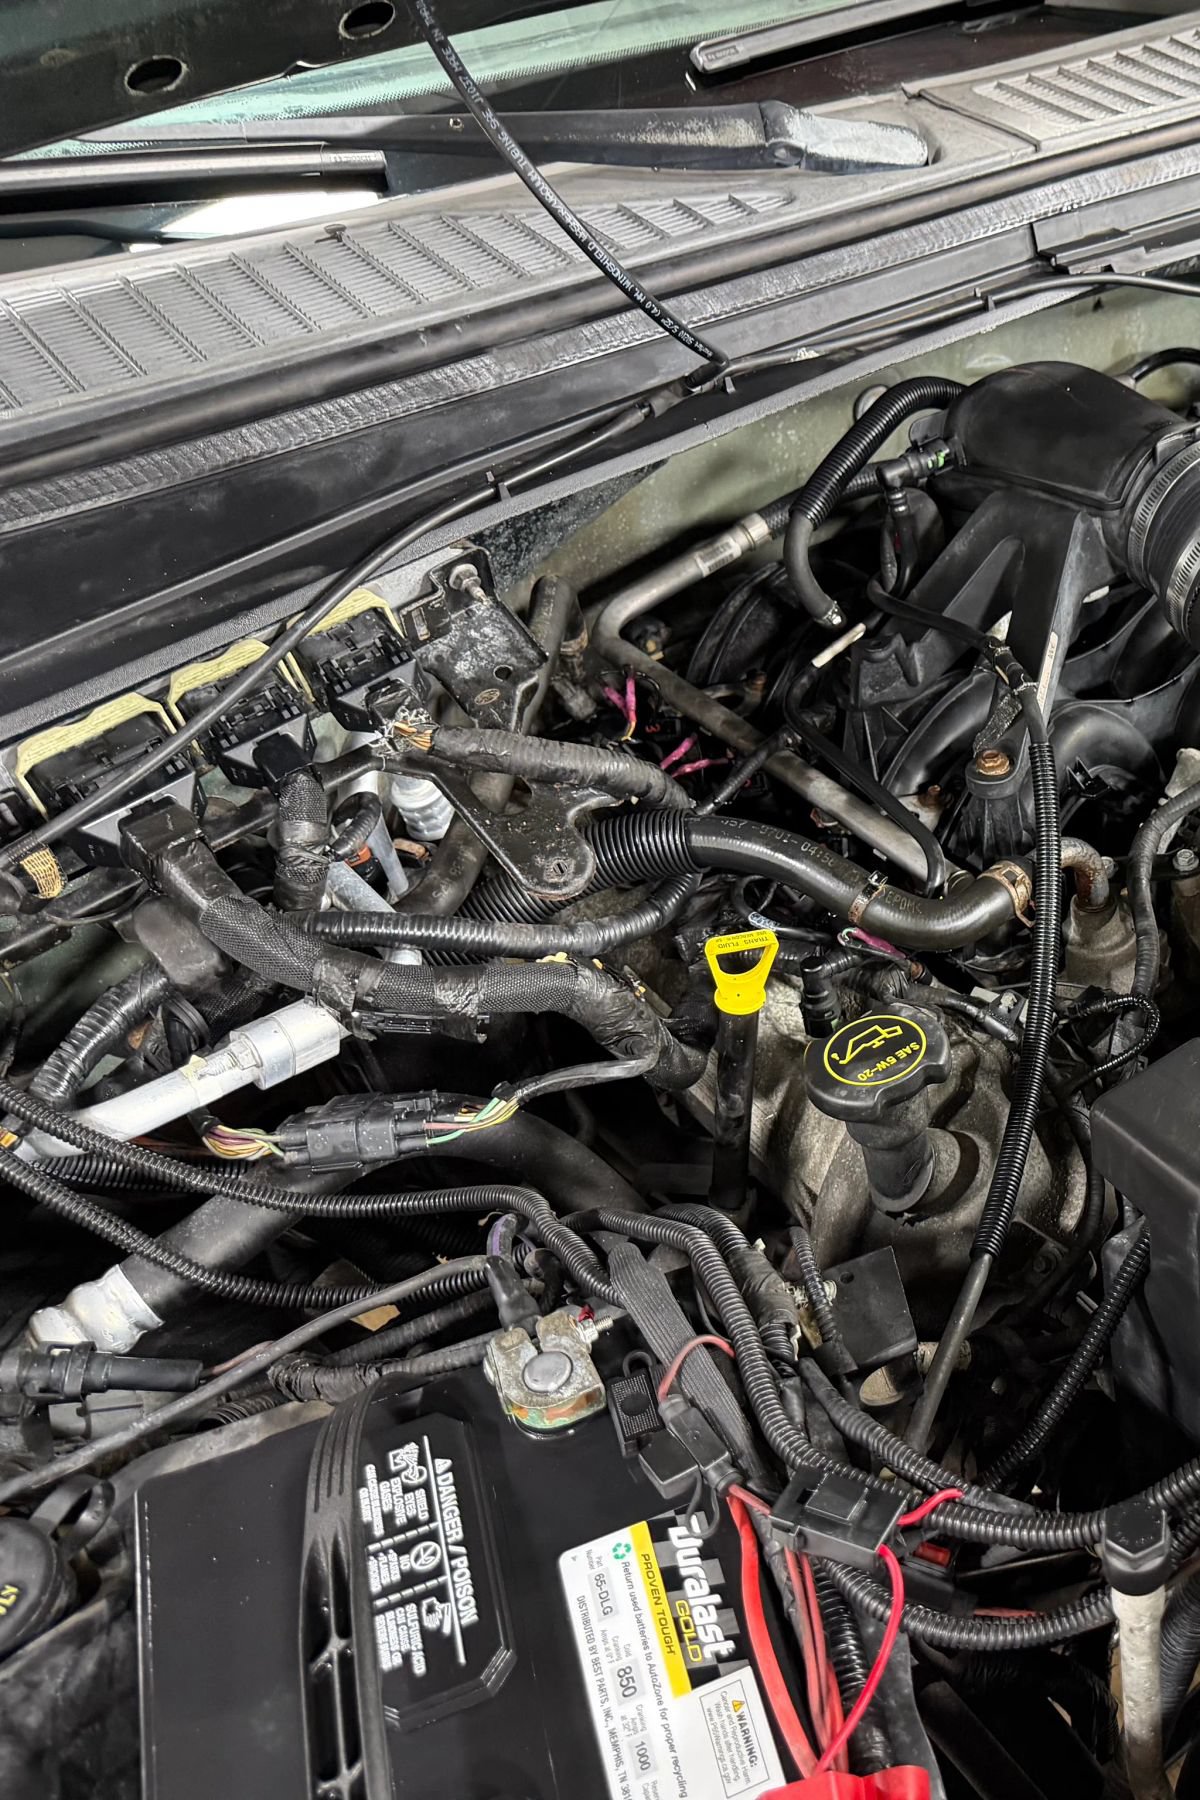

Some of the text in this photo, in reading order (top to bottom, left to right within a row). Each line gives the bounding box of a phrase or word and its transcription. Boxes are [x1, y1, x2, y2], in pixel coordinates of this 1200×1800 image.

[430, 27, 444, 42] IN
[441, 45, 463, 72] MADE
[458, 73, 484, 105] J1037
[481, 107, 500, 129] SAE
[497, 130, 528, 168] TUBING
[717, 935, 768, 948] TRANS FLUID
[857, 1041, 919, 1080] SAE 5W-20
[379, 1480, 392, 1513] GASES
[389, 1476, 407, 1527] EXPLOSIVE
[404, 1491, 416, 1518] EYES
[414, 1487, 429, 1521] SHIELD
[435, 1471, 464, 1543] DANGER
[399, 1554, 410, 1571] NO
[585, 1549, 595, 1570] Number
[449, 1555, 478, 1628] POISON
[593, 1572, 613, 1616] 65-DLG
[641, 1552, 662, 1605] PROVEN
[667, 1514, 734, 1659] Duralast
[395, 1606, 405, 1624] CAN
[576, 1595, 594, 1644] DISTRIBUTED
[674, 1599, 703, 1663] GOLD
[404, 1602, 426, 1676] SULFURIC ACID
[588, 1644, 597, 1656] BY
[590, 1656, 602, 1676] BEST
[616, 1665, 638, 1698] 850
[621, 1560, 689, 1798] Return used batteries to AutoZone for proper recycling
[595, 1677, 609, 1707] PARTS,
[720, 1690, 731, 1713] Cancer
[714, 1702, 723, 1719] Wash
[726, 1713, 735, 1725] and
[718, 1719, 729, 1738] hands
[735, 1711, 758, 1767] WARNING:
[607, 1727, 624, 1770] MEMPHIS,
[634, 1740, 651, 1771] 1000
[724, 1739, 733, 1753] after
[729, 1725, 746, 1766] Reproductive
[617, 1770, 627, 1782] TN
